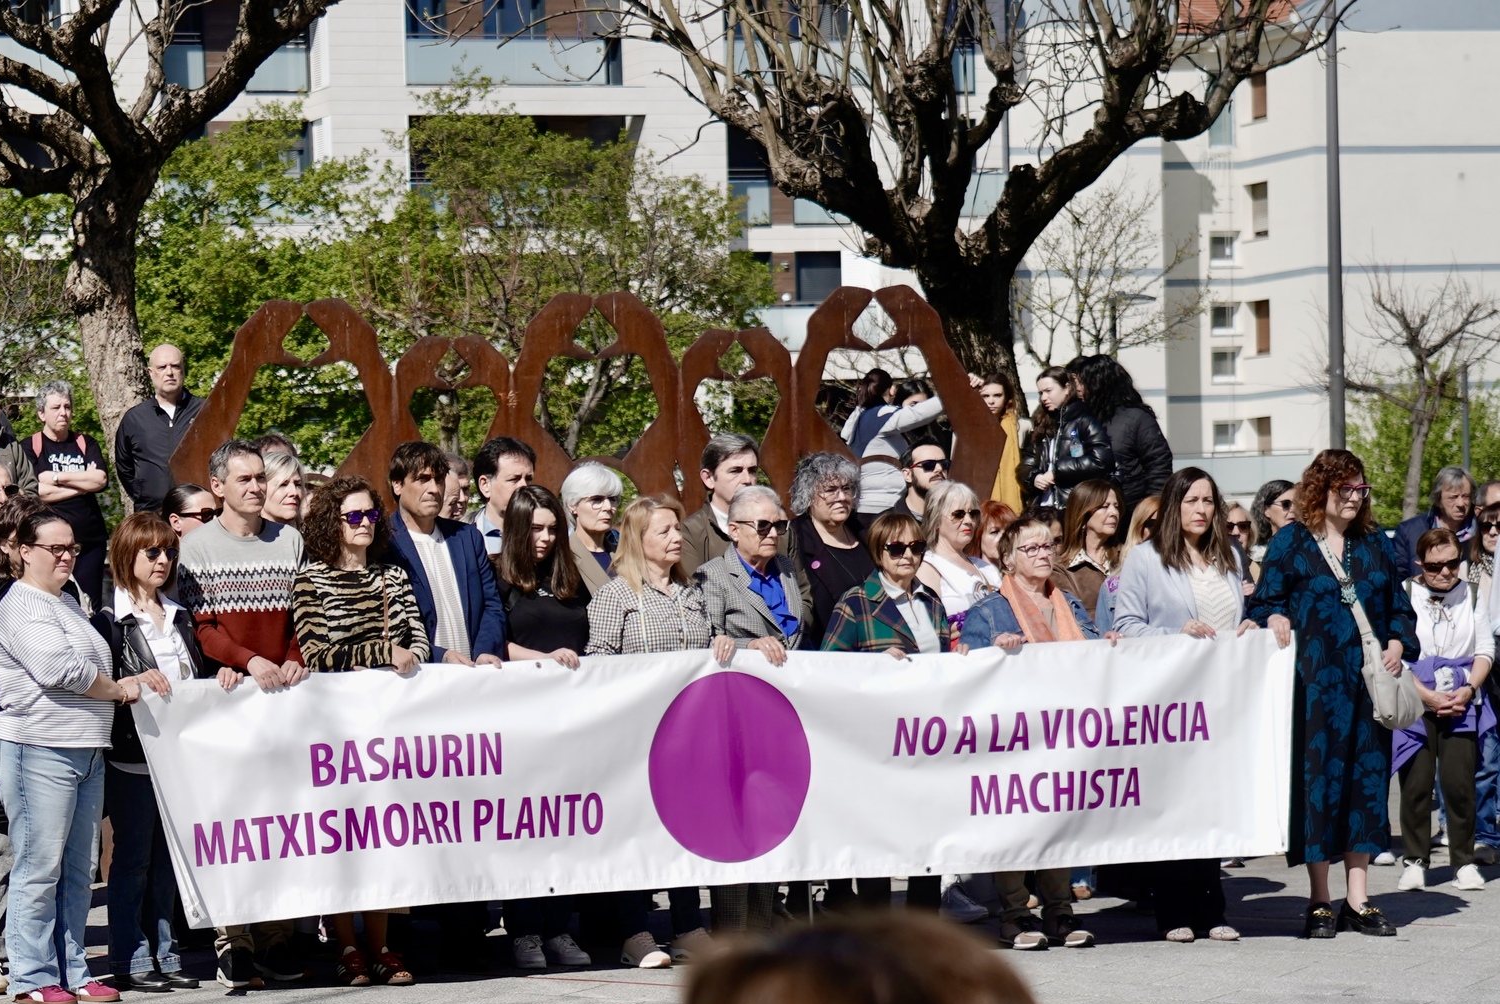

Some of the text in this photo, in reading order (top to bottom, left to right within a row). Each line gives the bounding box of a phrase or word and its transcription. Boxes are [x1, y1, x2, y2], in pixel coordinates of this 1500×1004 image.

[894, 701, 1210, 756] NO A LA VIOLENCIA
[310, 735, 502, 786] BASAURIN
[971, 768, 1140, 814] MACHISTA
[194, 792, 603, 866] MATXISMOARI PLANTO
